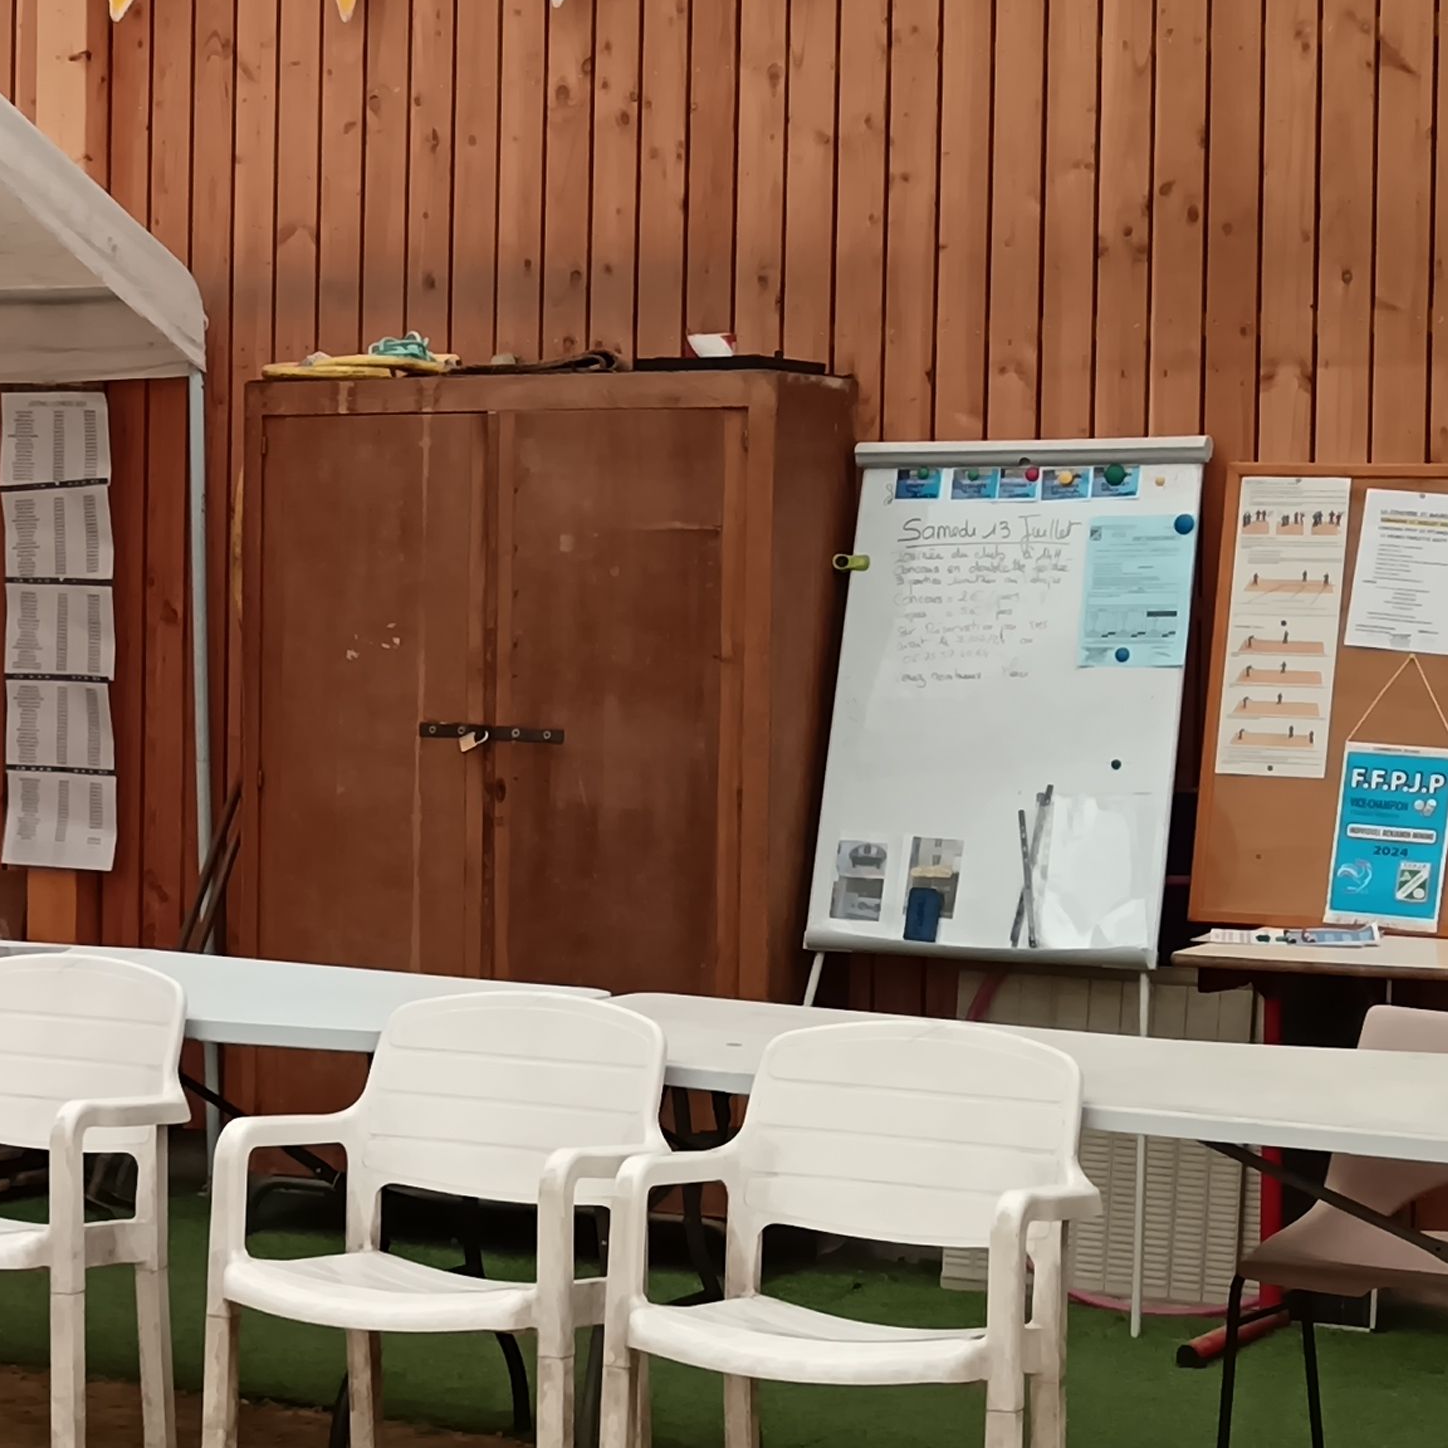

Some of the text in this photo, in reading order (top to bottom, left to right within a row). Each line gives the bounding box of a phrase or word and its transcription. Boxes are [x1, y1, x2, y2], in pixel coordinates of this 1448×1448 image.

[897, 514, 1082, 548] Samedi 13 Juillet
[1350, 767, 1447, 795] F.F.P.J.P
[1372, 845, 1409, 858] 2024
